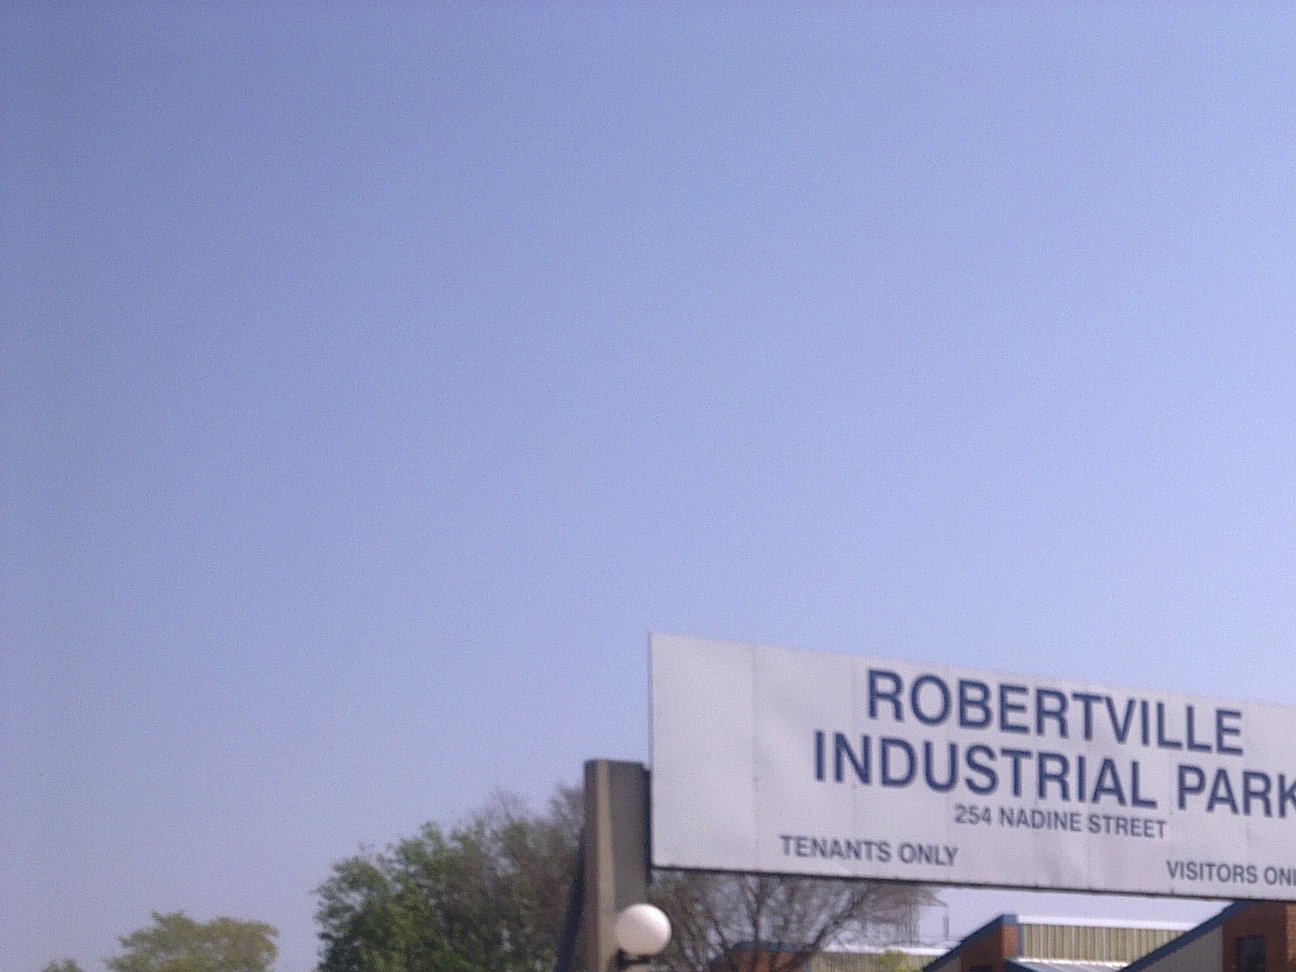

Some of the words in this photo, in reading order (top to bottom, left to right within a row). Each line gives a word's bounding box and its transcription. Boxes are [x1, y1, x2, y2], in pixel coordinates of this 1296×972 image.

[867, 668, 1244, 756] ROBERTVILLE
[813, 730, 1157, 810] INDUSTRIAL
[954, 804, 993, 827] 254
[999, 807, 1083, 833] NADINE
[1089, 811, 1168, 839] STREET
[780, 835, 892, 863] TENANTS
[899, 842, 958, 867] ONLY
[1166, 860, 1259, 886] VISITORS
